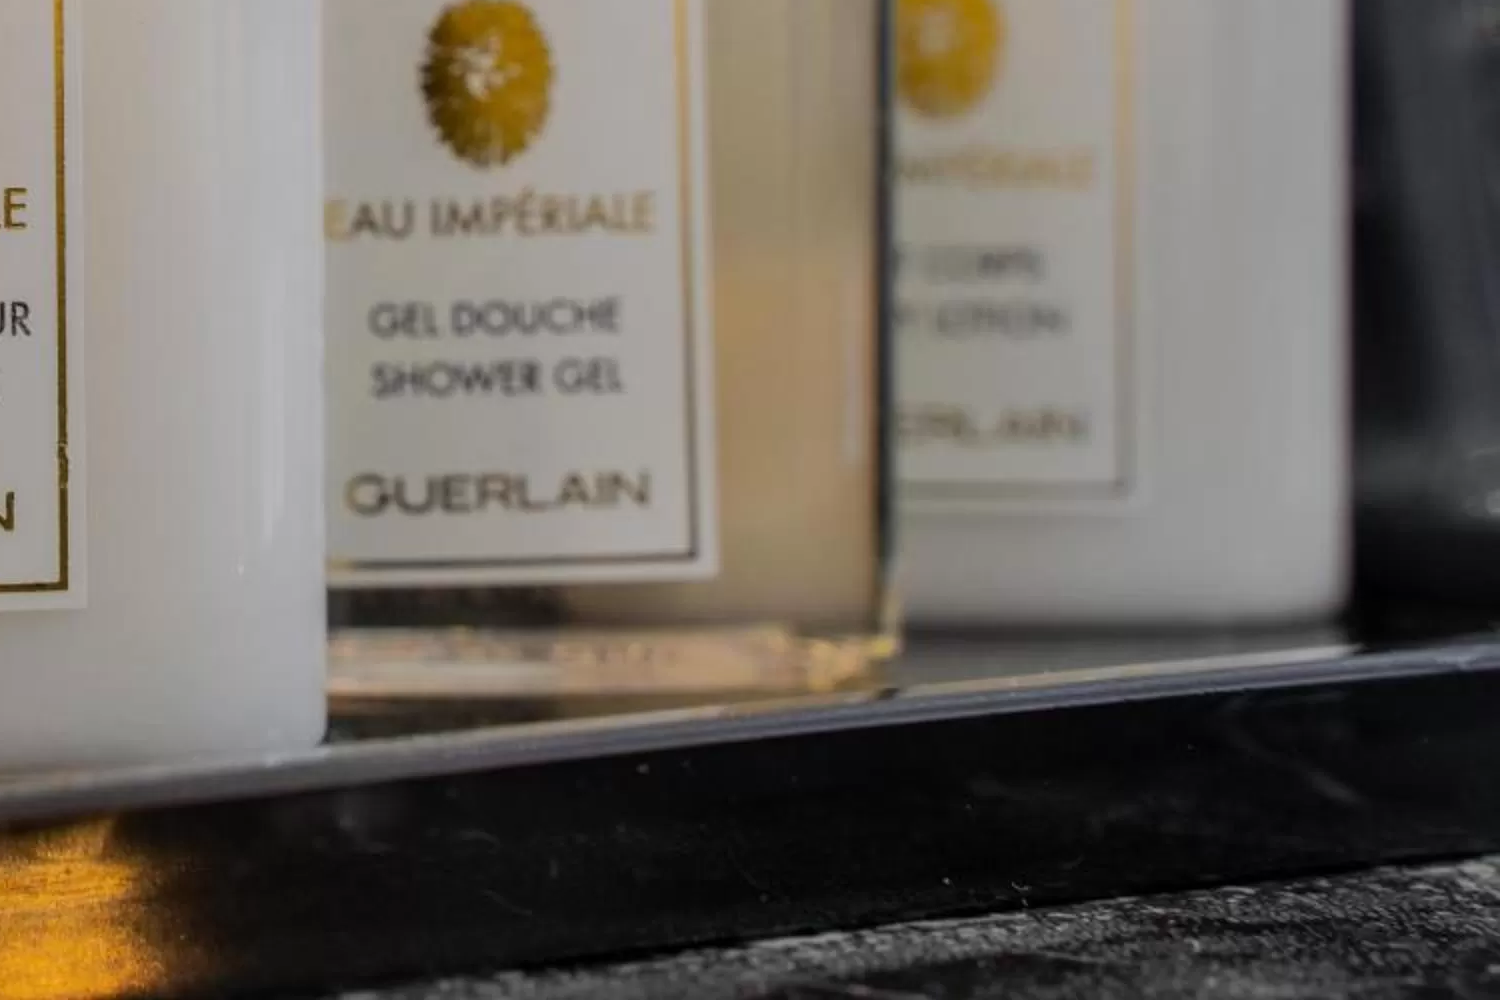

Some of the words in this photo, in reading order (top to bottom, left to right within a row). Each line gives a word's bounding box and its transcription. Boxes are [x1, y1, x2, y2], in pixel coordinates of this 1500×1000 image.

[324, 199, 415, 240] EAU
[430, 185, 655, 236] IMPÉRIALE
[368, 302, 438, 338] GEL
[451, 298, 621, 336] DOUCHE
[372, 359, 542, 397] SHOWER
[553, 355, 625, 394] GEL
[344, 470, 653, 517] GUERLAIN
